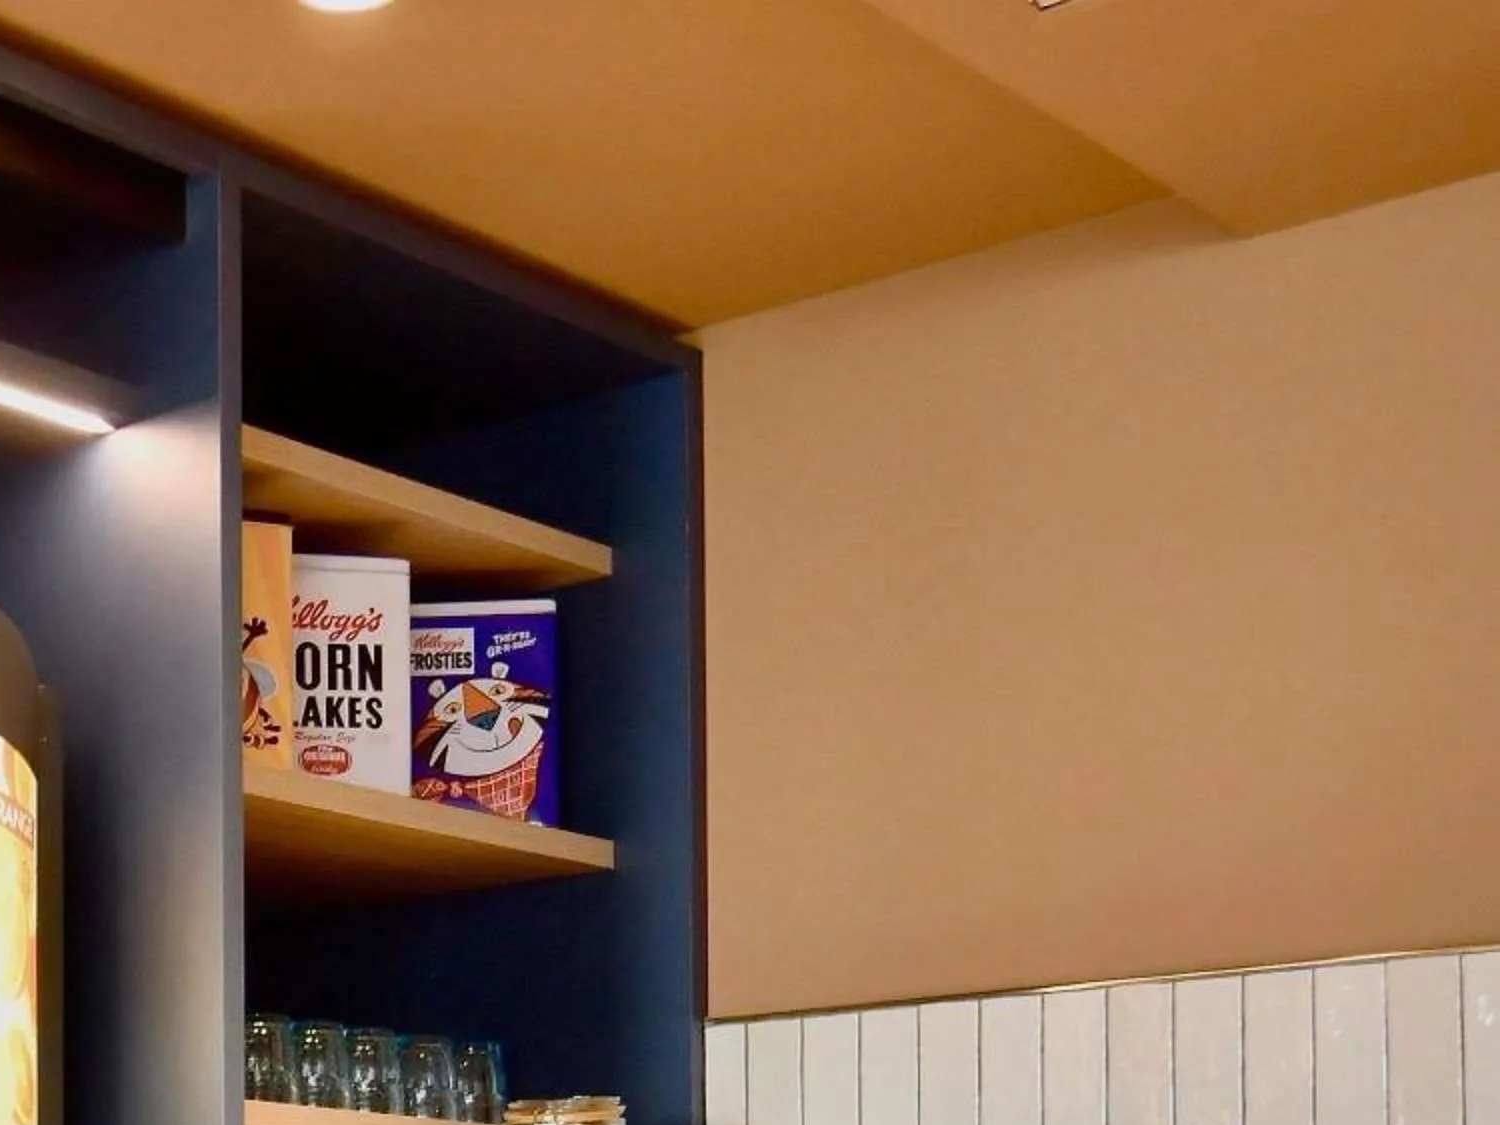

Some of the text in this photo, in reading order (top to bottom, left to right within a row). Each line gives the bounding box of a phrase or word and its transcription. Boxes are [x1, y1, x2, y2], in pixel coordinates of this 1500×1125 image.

[293, 596, 382, 642] llogg's
[295, 641, 383, 692] ORN
[410, 651, 472, 670] FROSTIES
[292, 696, 383, 729] AKES
